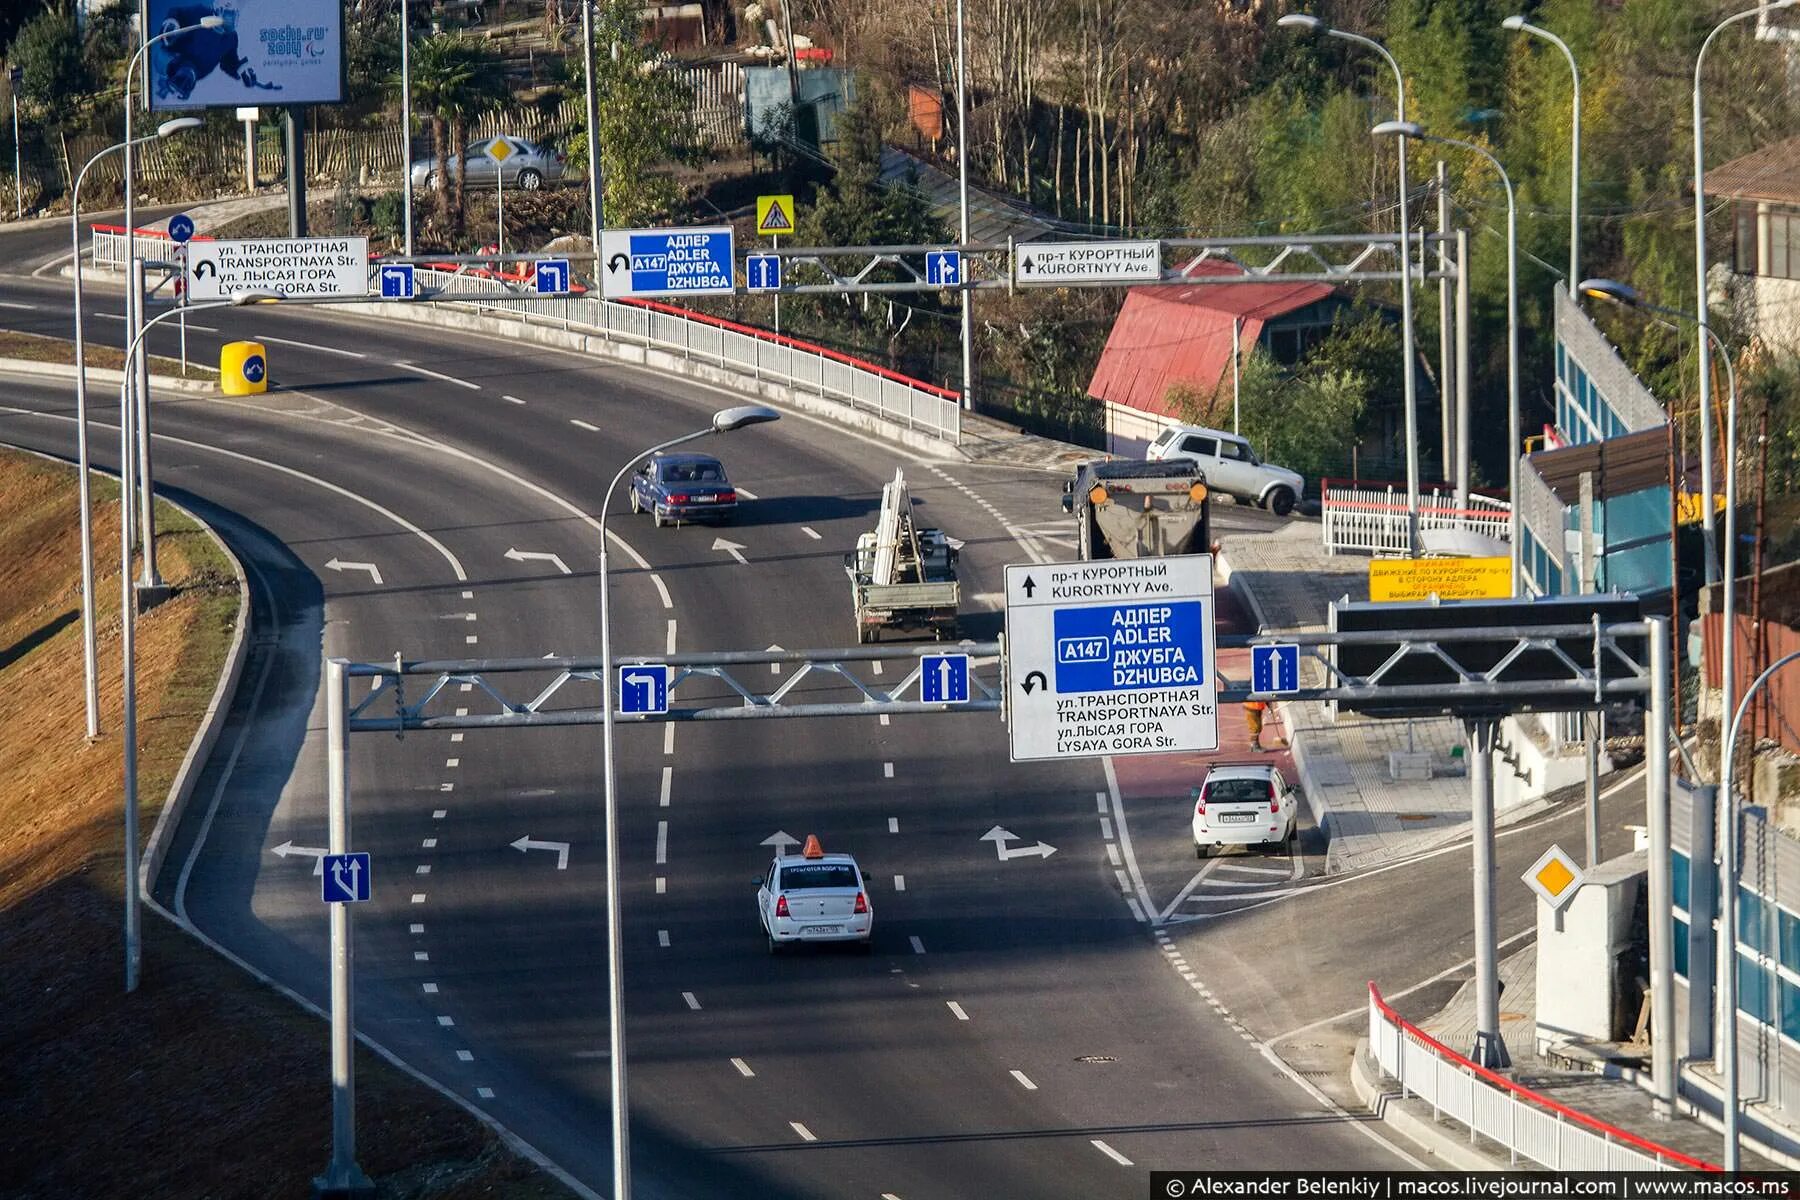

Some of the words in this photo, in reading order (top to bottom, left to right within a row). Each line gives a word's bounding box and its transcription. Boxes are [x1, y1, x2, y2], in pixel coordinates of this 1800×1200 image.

[259, 24, 325, 42] sochi.ru
[666, 235, 710, 248] АДЛЕР
[218, 247, 236, 257] ул.
[240, 242, 348, 255] ТРАНСПОРТНАЯ
[668, 249, 710, 261] ADLER
[1038, 253, 1065, 262] пр-т
[1069, 246, 1155, 260] КУРОРТНЫЙ
[219, 256, 336, 268] TRANSPORTNAYA
[337, 255, 358, 266] Str.
[668, 262, 720, 276] ДЖУБГА
[1038, 262, 1121, 274] KURORTNYY
[1124, 262, 1152, 272] Ave.
[219, 273, 237, 284] ул.
[243, 270, 296, 281] ЛЫСАЯ
[300, 269, 336, 279] ГОРА
[667, 276, 729, 288] DZHUBGA
[274, 282, 315, 294] GORA
[319, 282, 341, 293] Str.
[1052, 572, 1078, 584] пр-т
[1082, 562, 1167, 580] КУРОРТНЫЙ
[1373, 569, 1417, 577] ДВИЖЕНИЕ
[1446, 575, 1478, 583] АДЛЕРА
[1052, 582, 1141, 598] KURORTNYY
[1144, 582, 1173, 593] Ave.
[1112, 608, 1171, 628] АДЛЕР
[1112, 627, 1171, 645] ADLER
[1113, 647, 1185, 668] ДЖУБГА
[1113, 666, 1198, 686] DZHUBGA
[1057, 705, 1187, 723] TRANSPORTNAYA
[1192, 705, 1213, 715] Str.
[1130, 722, 1163, 734] ГОРА
[1057, 740, 1107, 752] LYSAYA
[1112, 737, 1152, 749] GORA
[1156, 736, 1177, 747] Str.
